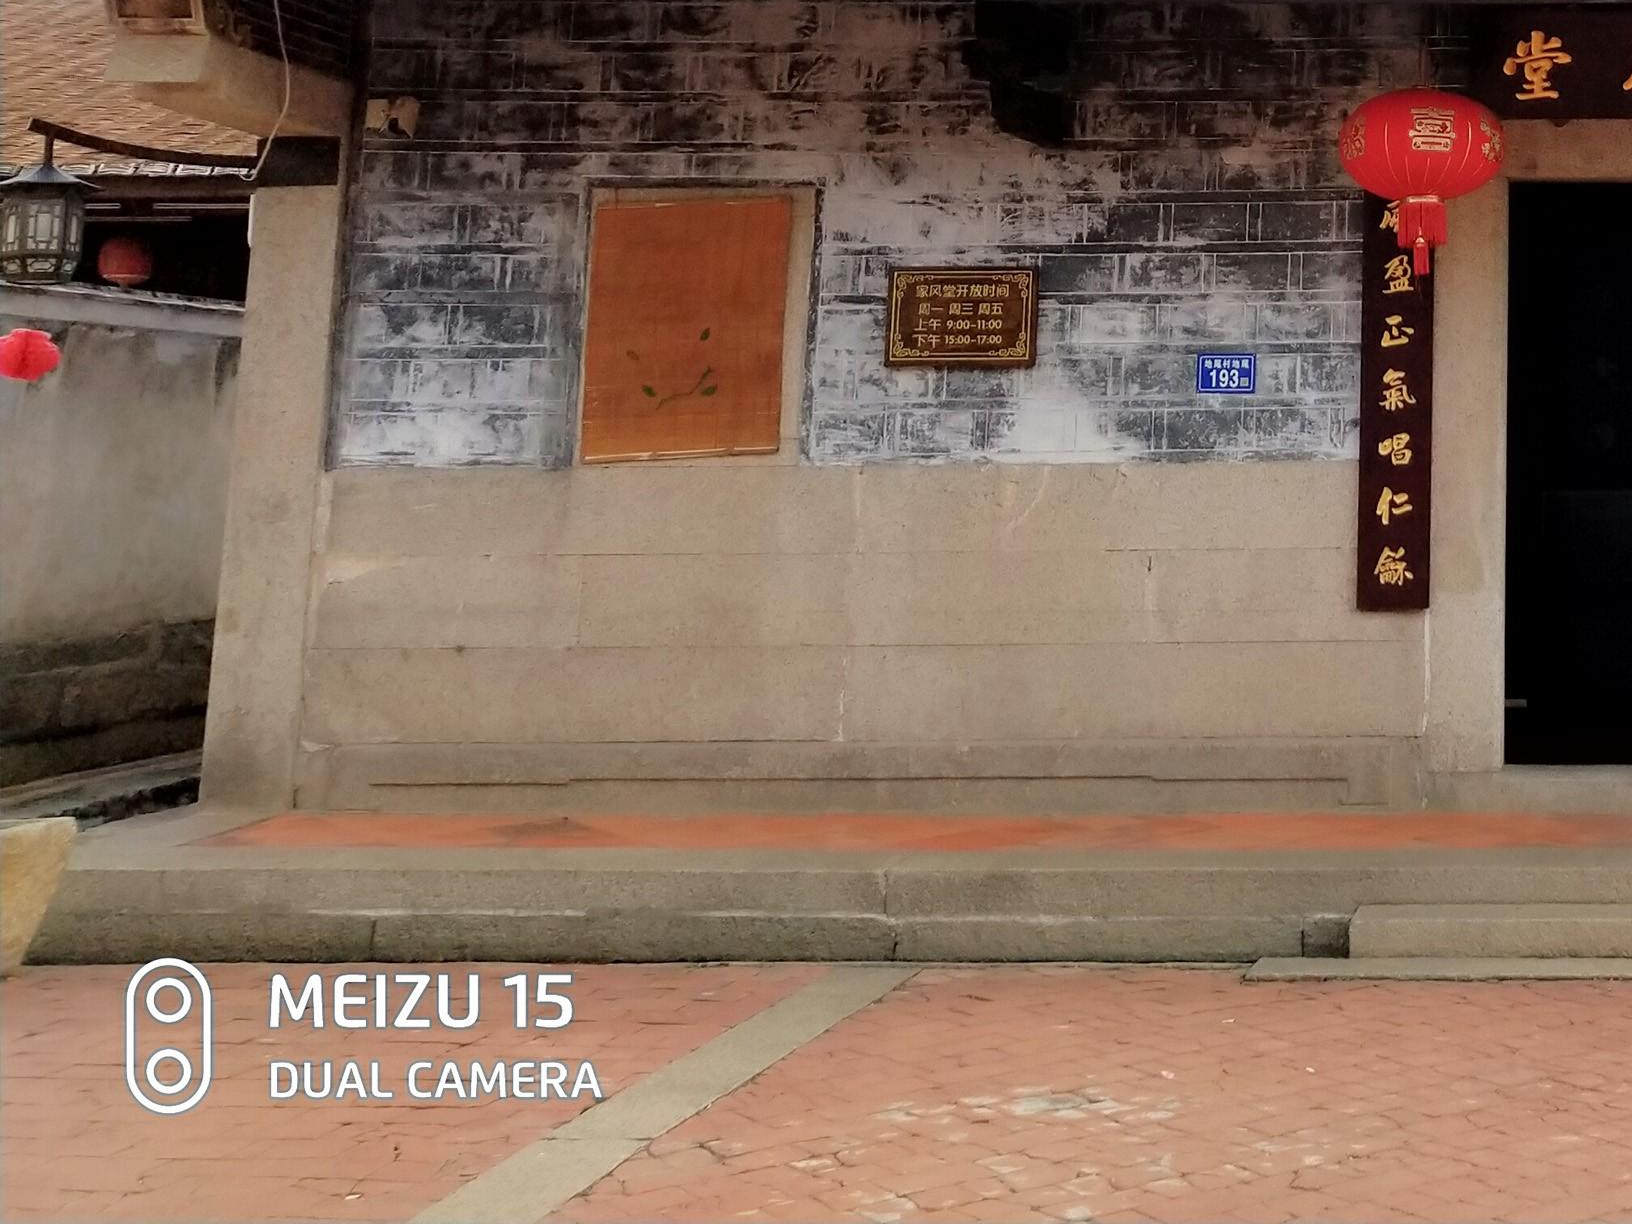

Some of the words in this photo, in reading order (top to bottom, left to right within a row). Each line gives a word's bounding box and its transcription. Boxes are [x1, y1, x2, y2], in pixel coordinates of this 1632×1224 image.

[916, 284, 1010, 298] 家风堂开放时间
[918, 303, 944, 315] 周一
[948, 303, 974, 315] 周三
[978, 302, 1004, 315] 周五
[914, 318, 942, 331] 上午
[912, 334, 941, 349] 下午
[945, 334, 1003, 345] 15:00-17:00
